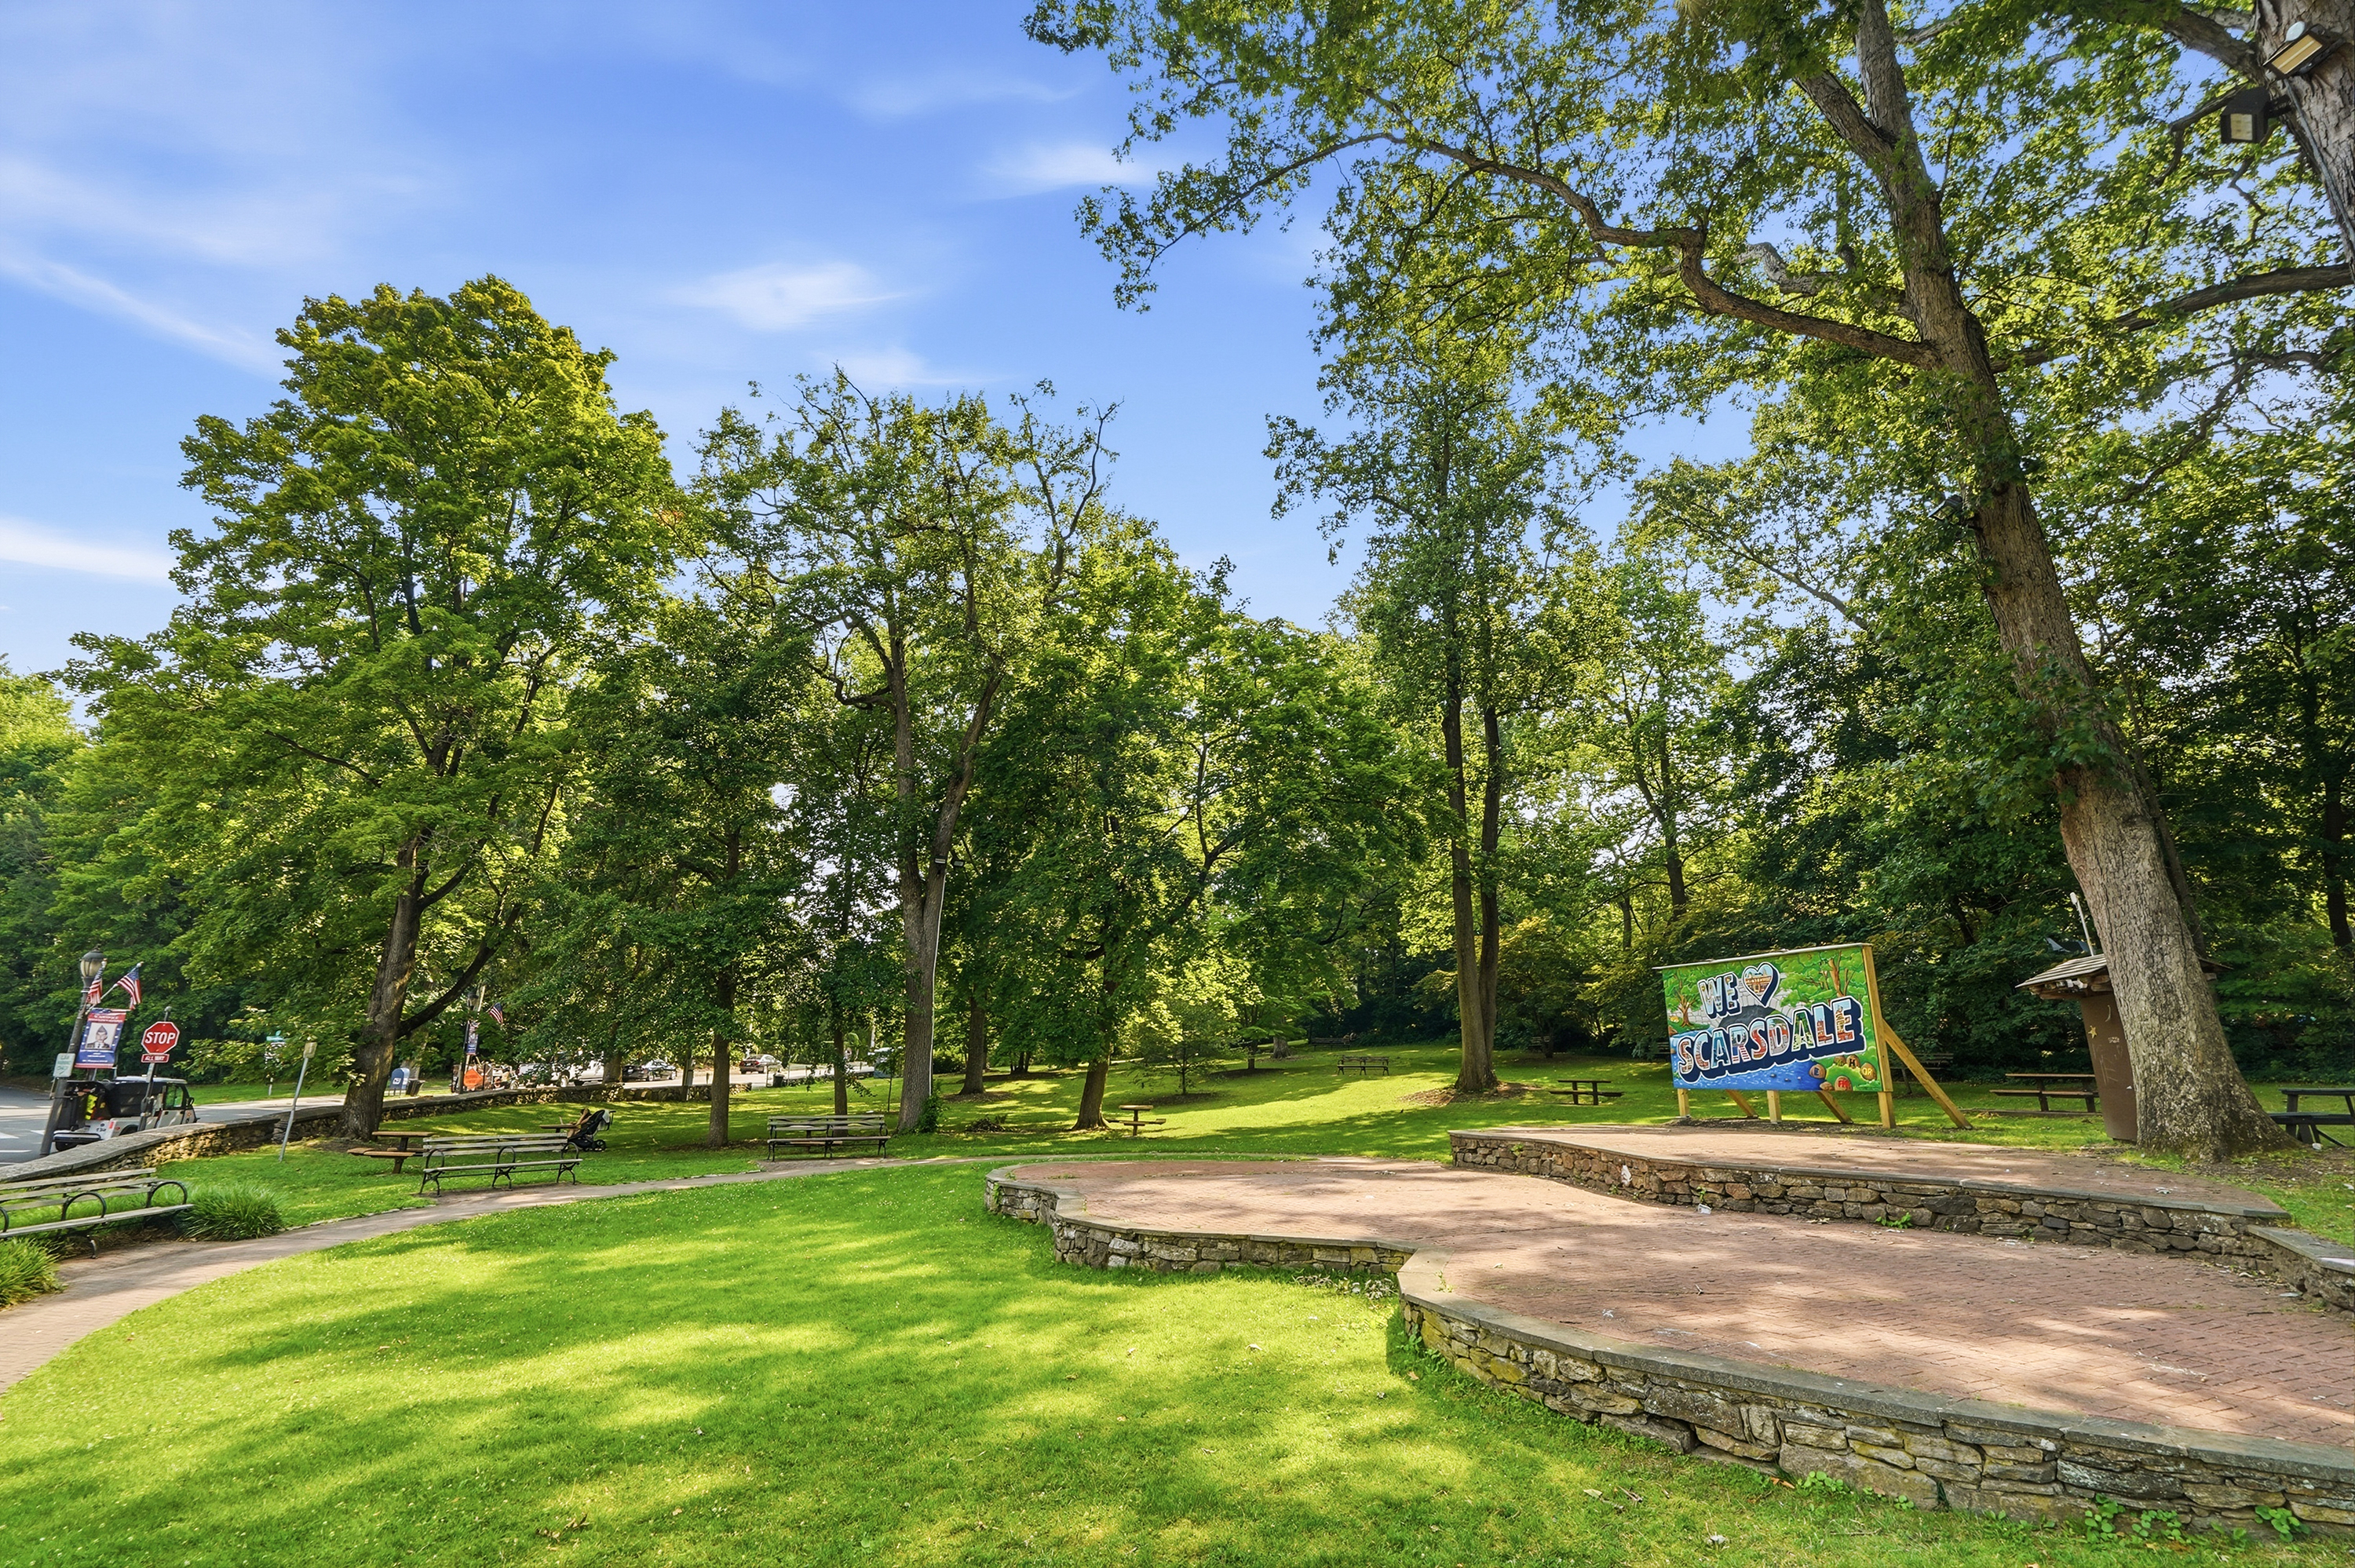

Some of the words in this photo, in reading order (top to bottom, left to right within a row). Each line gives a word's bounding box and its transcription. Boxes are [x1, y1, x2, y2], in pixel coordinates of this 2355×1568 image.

[1698, 973, 1741, 1019] WE
[144, 1032, 176, 1044] STOP
[1678, 997, 1864, 1081] SCARSDALE
